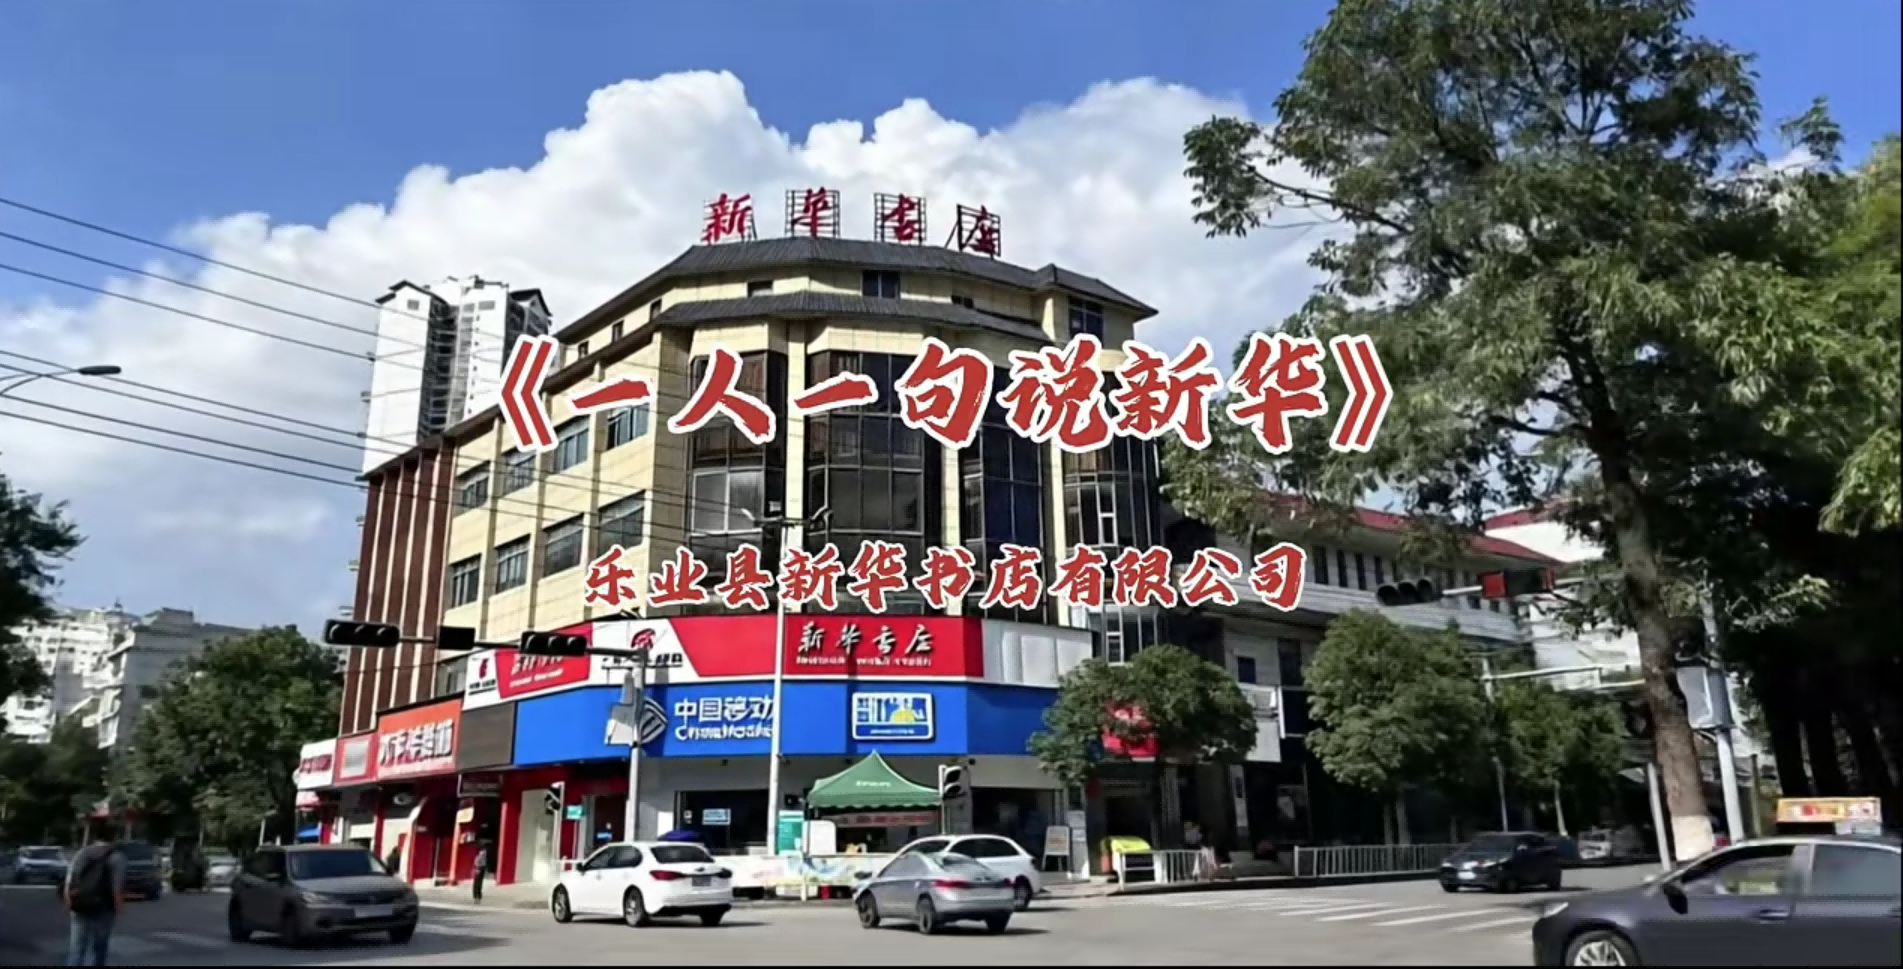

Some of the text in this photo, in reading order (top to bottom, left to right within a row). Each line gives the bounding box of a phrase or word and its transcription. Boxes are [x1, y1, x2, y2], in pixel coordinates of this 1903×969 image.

[702, 187, 1000, 257] 新华书店
[798, 621, 932, 654] 新华书店
[674, 694, 773, 724] 中国移动
